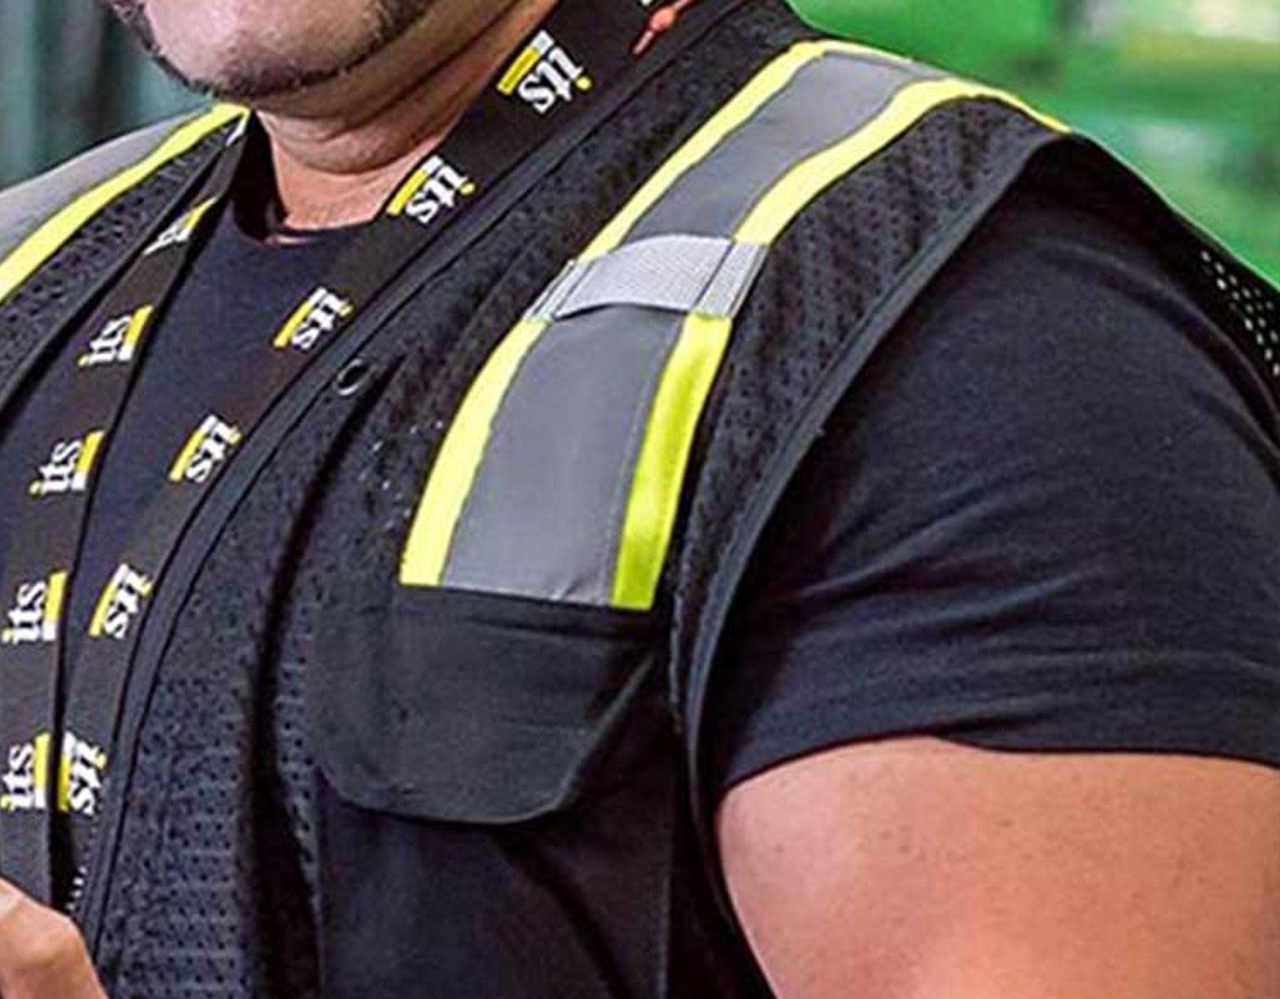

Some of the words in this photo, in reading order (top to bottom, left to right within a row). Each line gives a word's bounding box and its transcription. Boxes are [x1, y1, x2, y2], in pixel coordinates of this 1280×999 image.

[517, 46, 592, 114] its
[404, 164, 476, 225] its
[78, 314, 134, 367] its
[292, 291, 353, 350] its
[29, 438, 83, 496] its
[186, 420, 242, 483] its
[0, 579, 48, 645] its
[103, 566, 153, 640] its
[70, 737, 109, 817] its
